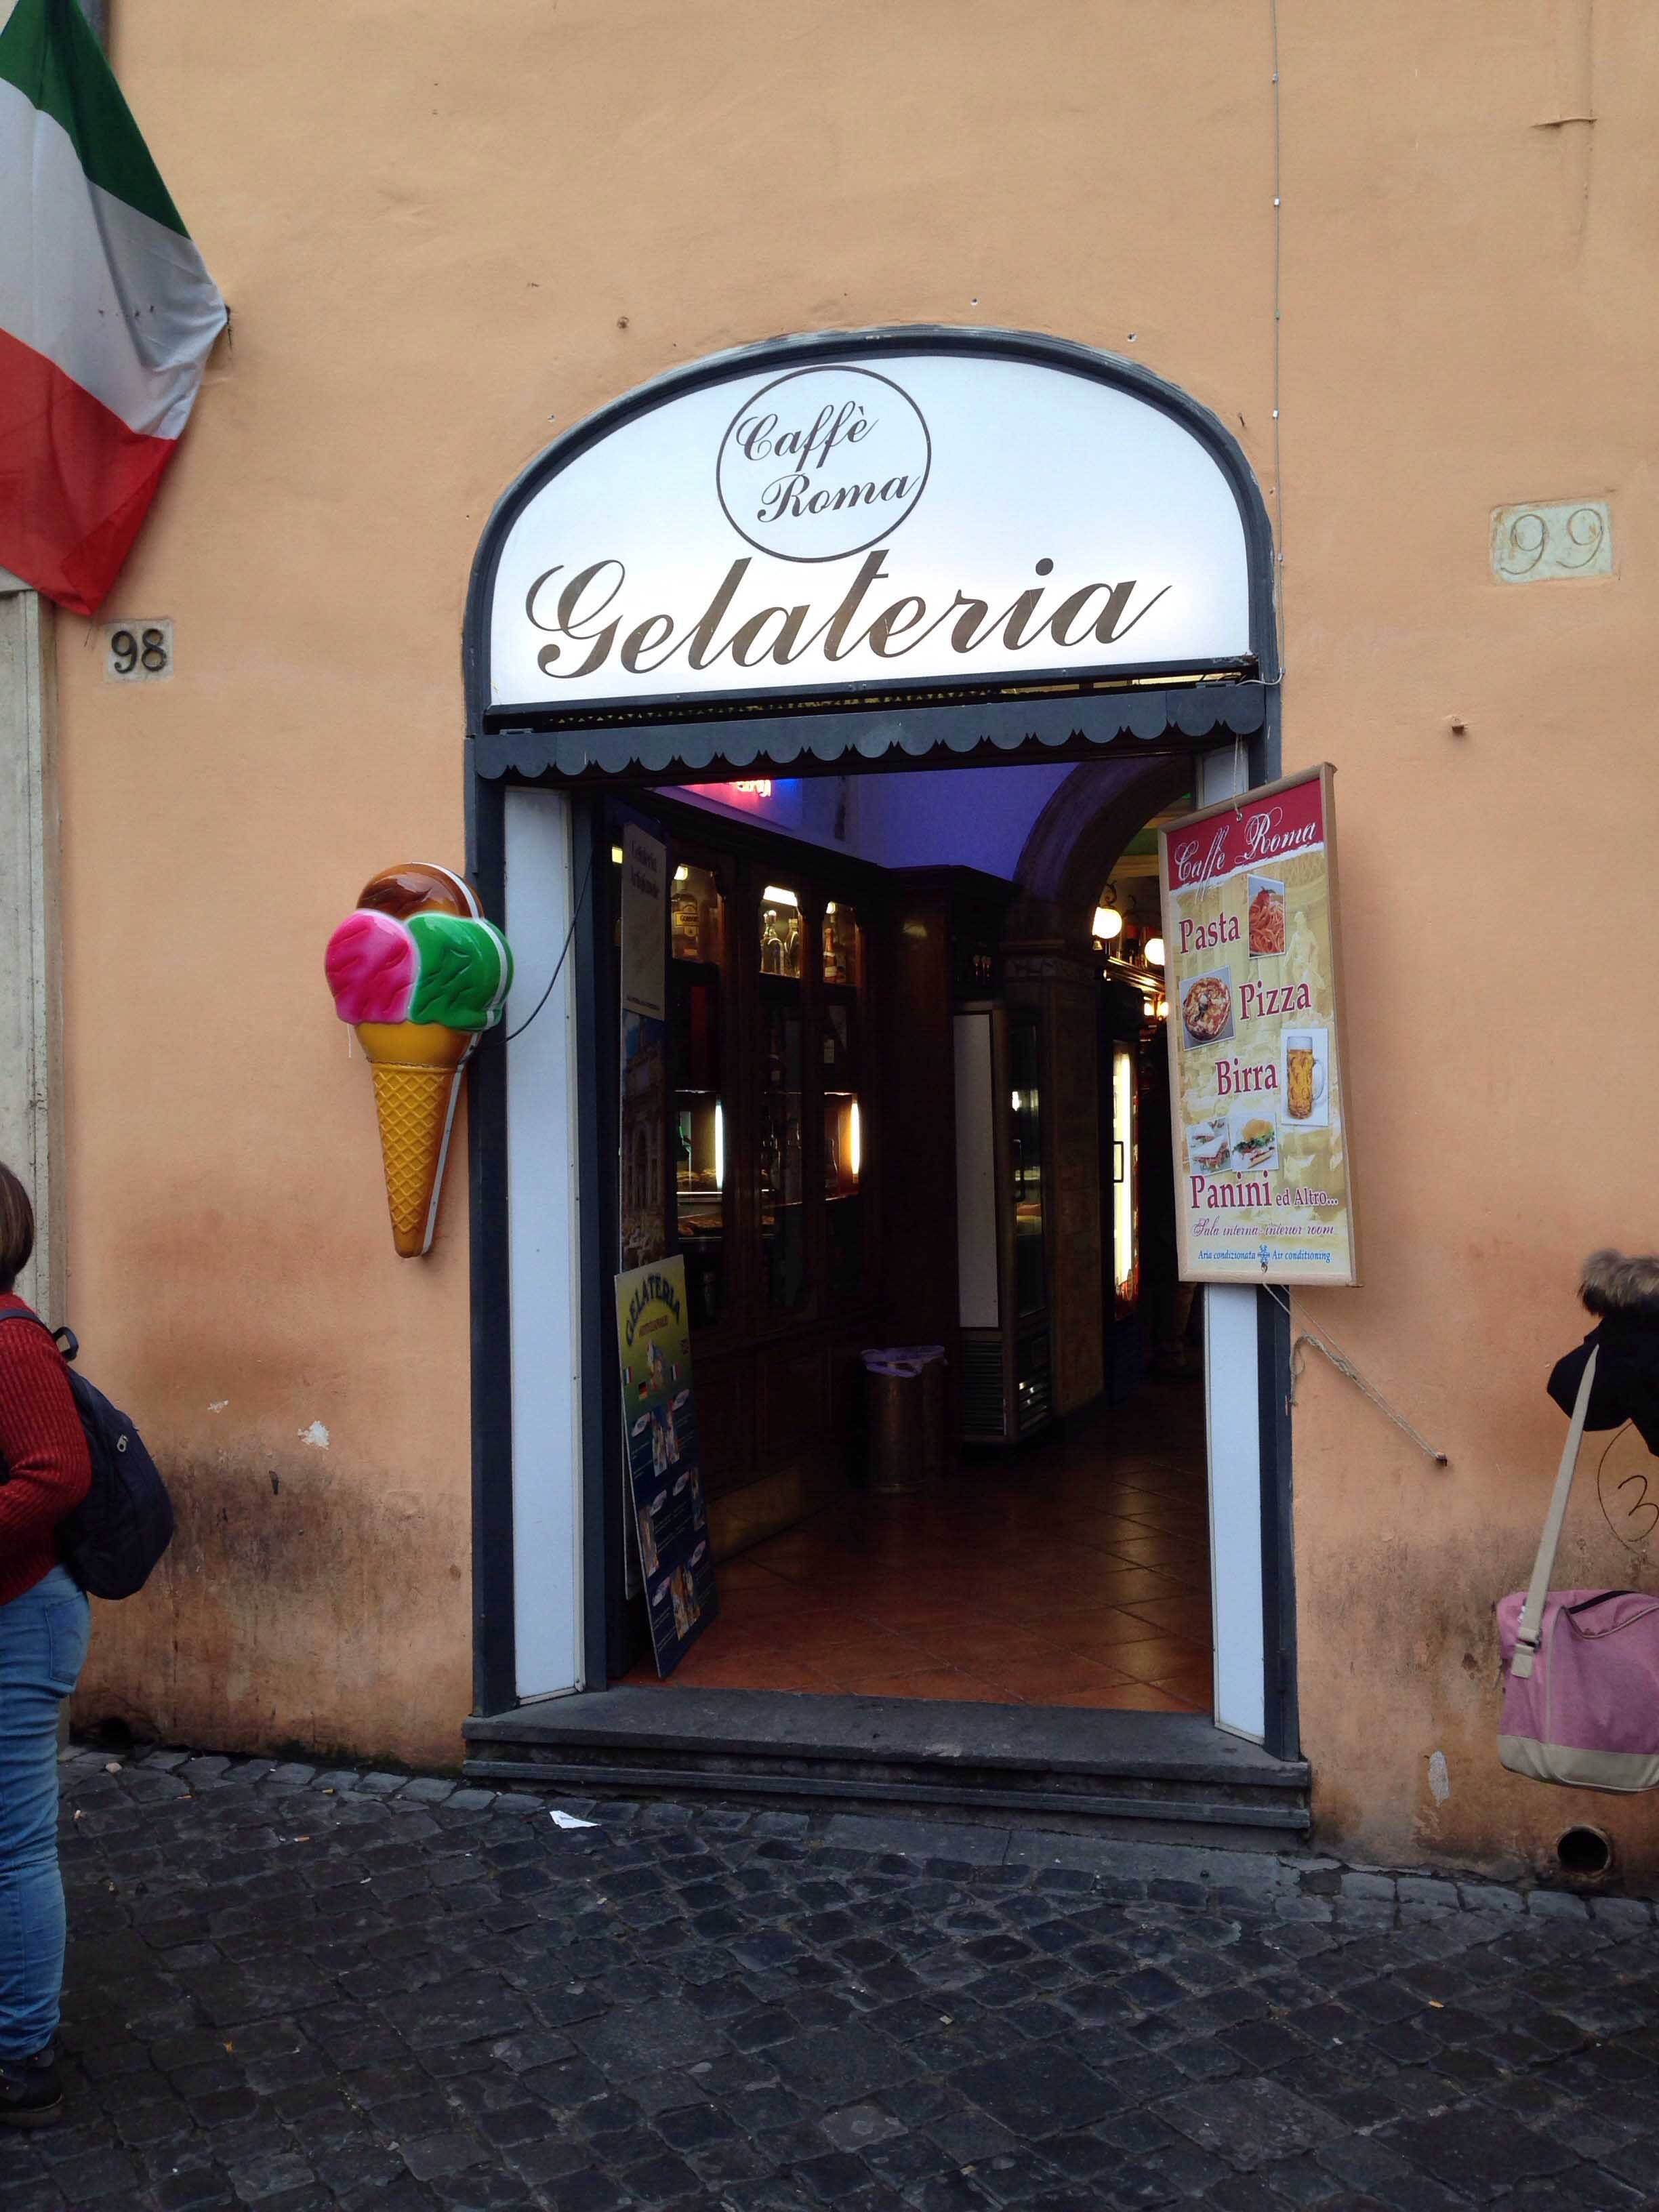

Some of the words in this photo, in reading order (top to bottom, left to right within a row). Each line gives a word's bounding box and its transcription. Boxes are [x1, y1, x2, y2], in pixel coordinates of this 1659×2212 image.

[736, 401, 879, 473] Caffè
[757, 470, 922, 524] Roma
[1500, 508, 1604, 575] 99
[525, 549, 1172, 678] Gelateria
[111, 628, 167, 674] 98
[1234, 806, 1316, 865] Roma
[1179, 910, 1241, 954] Pasta
[1239, 981, 1311, 1020] Pizza
[1214, 1057, 1278, 1096] Birra
[1189, 1170, 1273, 1209] Panini
[1275, 1189, 1290, 1207] ed
[1293, 1187, 1338, 1206] Altro...
[1192, 1215, 1221, 1237] Sala
[1307, 1225, 1334, 1235] room
[1198, 1249, 1212, 1260] Aria
[1213, 1247, 1256, 1261] condizionata
[1272, 1250, 1284, 1260] Air
[1284, 1248, 1331, 1263] conditioning
